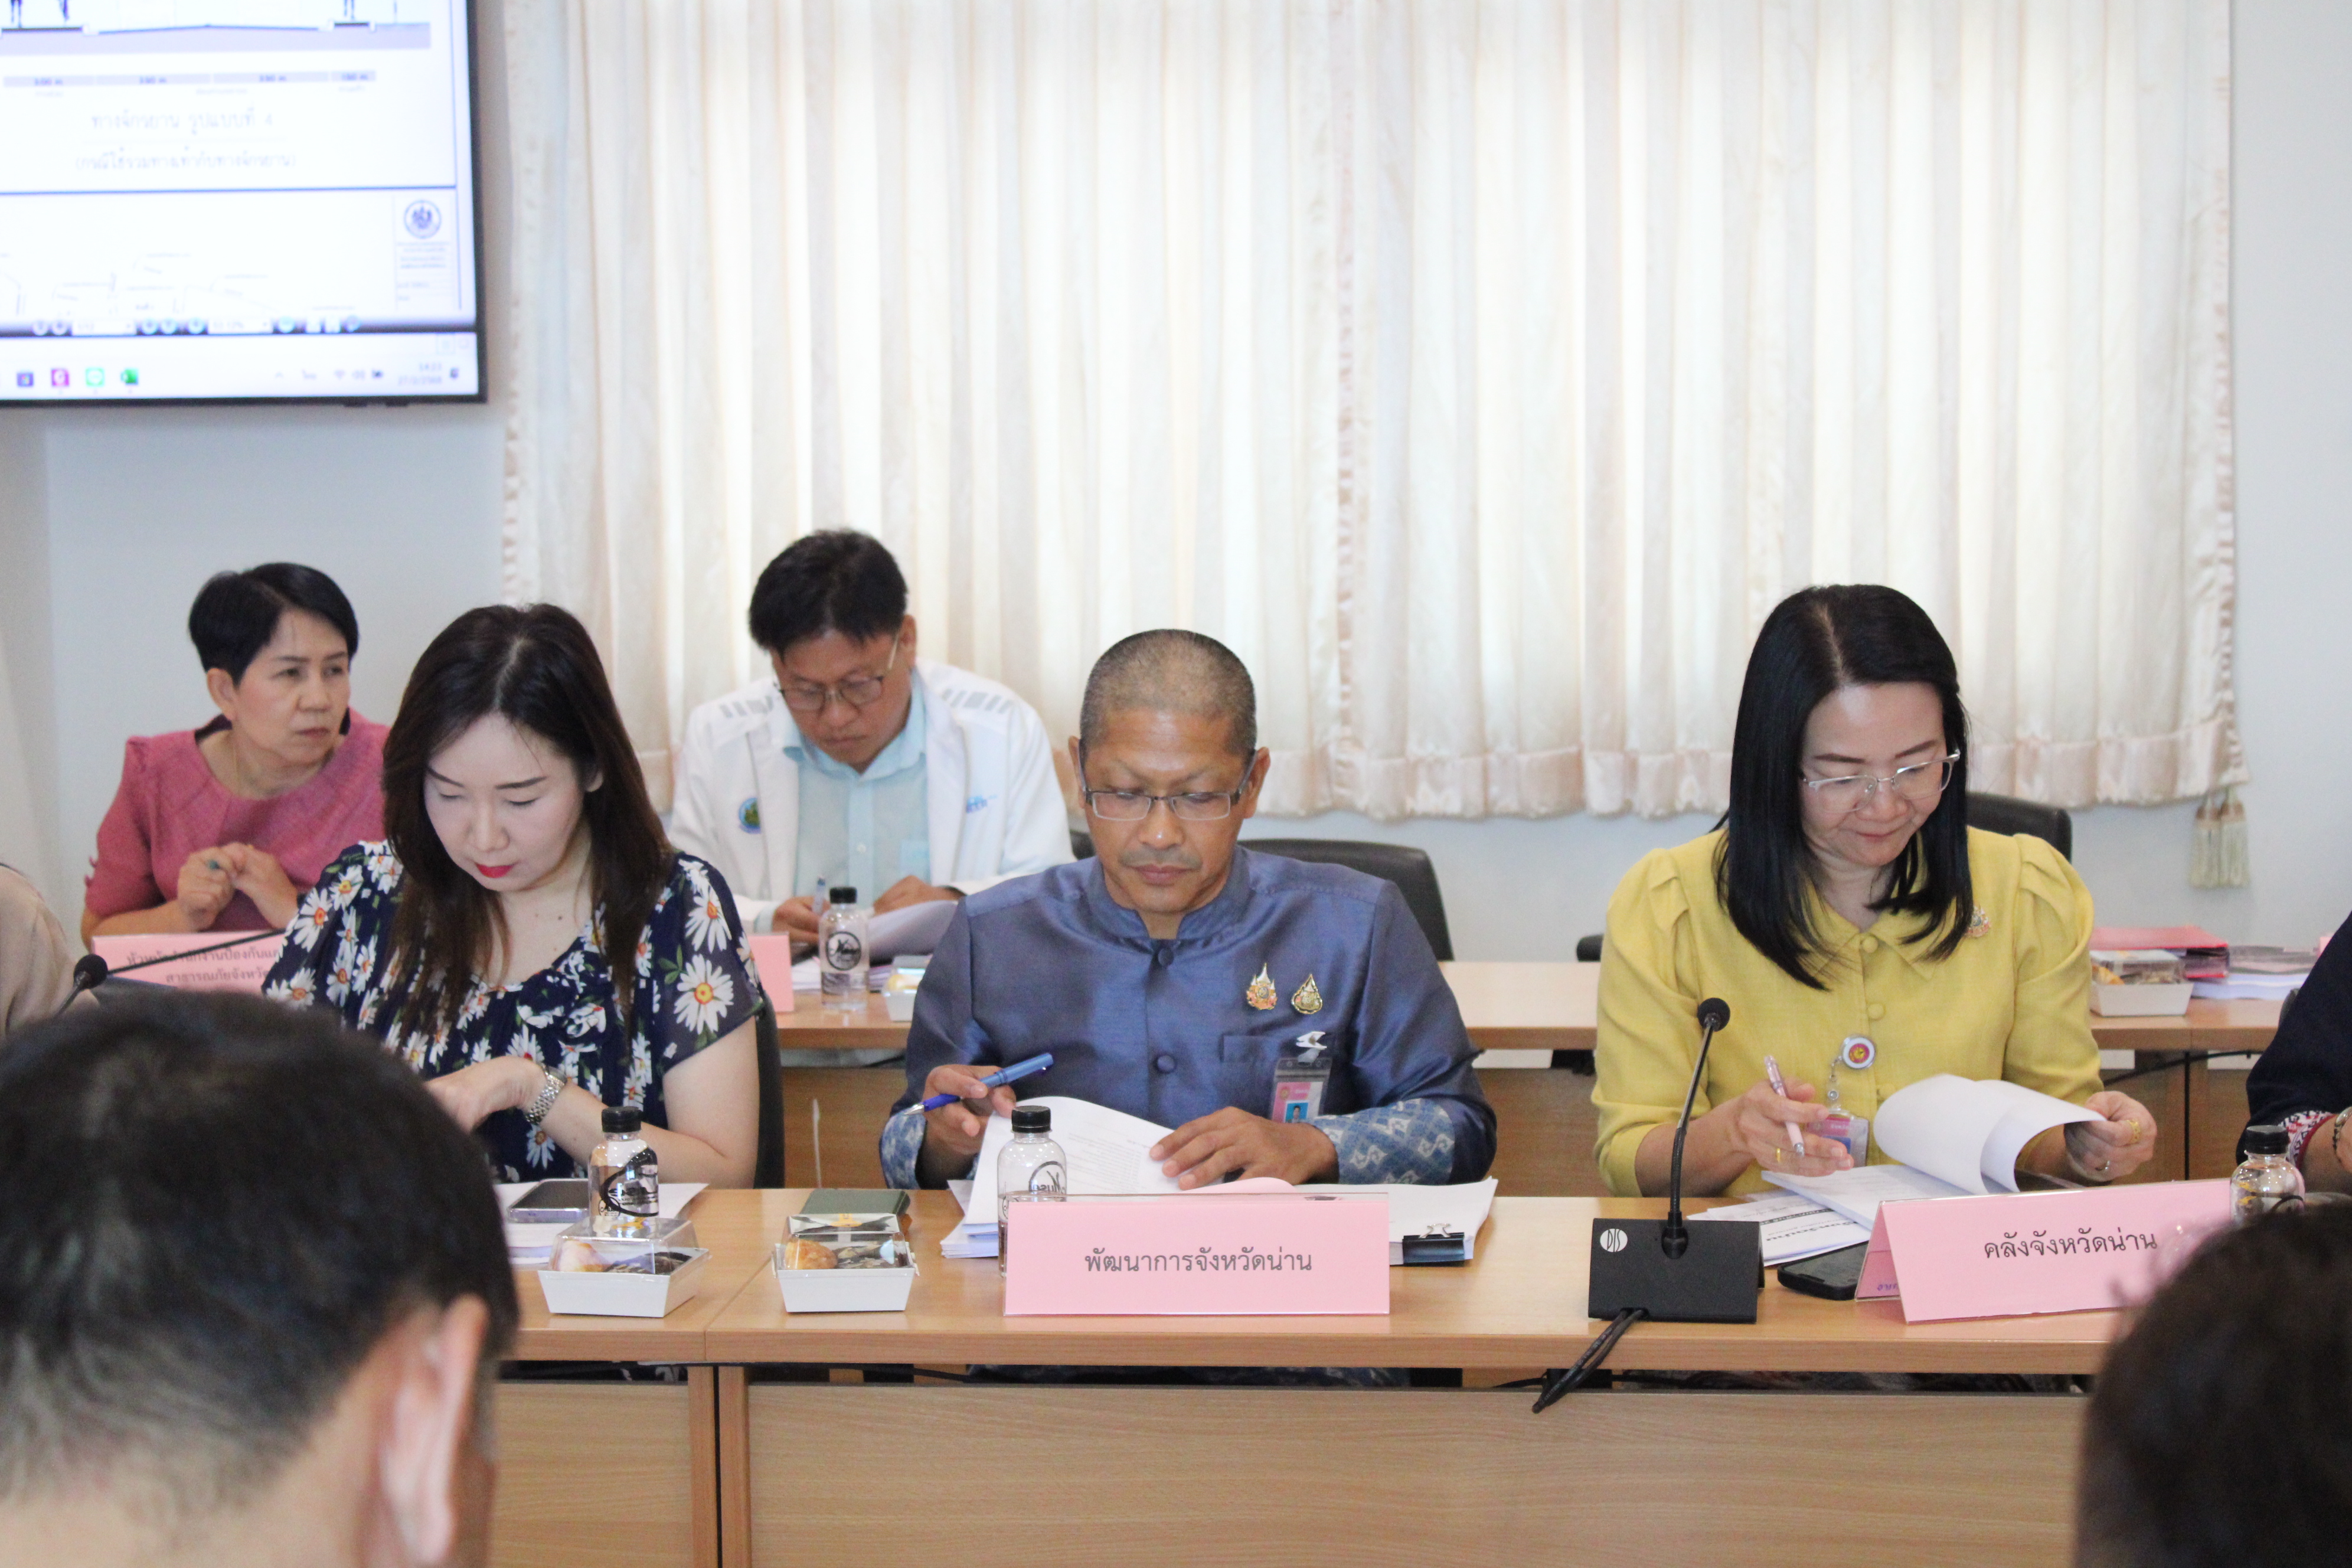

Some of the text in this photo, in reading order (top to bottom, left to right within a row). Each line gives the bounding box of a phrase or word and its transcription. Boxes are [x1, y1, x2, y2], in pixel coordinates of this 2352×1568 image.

[1984, 1226, 2158, 1259] คลังจังหวัดน่าน
[1084, 1246, 1313, 1273] พัฒนาการจังหวัดน่าน
